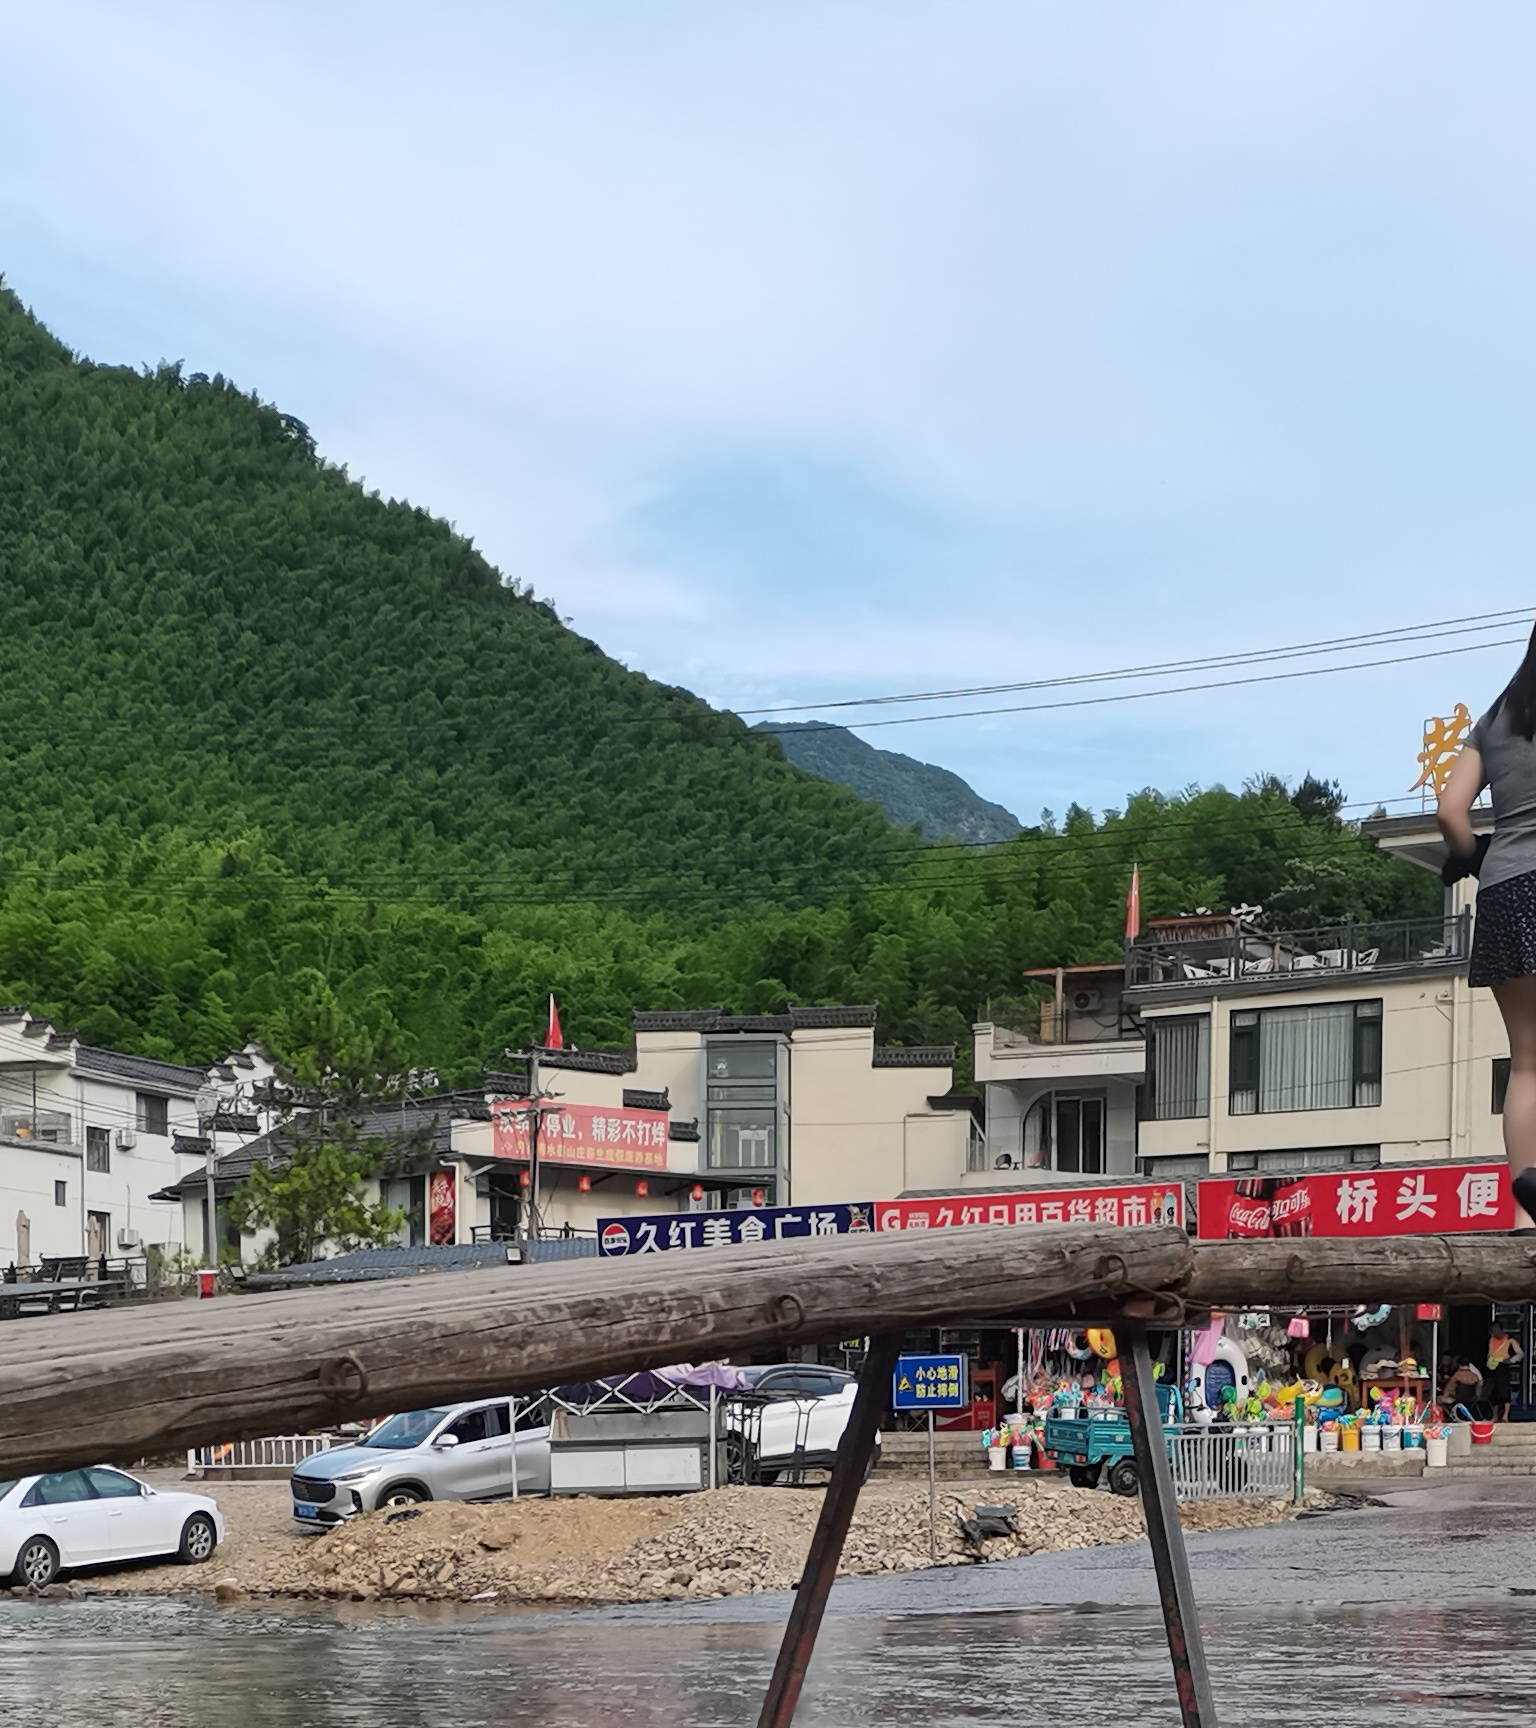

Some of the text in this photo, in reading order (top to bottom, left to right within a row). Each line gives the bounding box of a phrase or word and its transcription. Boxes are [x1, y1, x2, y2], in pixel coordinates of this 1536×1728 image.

[936, 1195, 1147, 1228] 久红日用百货超市
[635, 1211, 839, 1254] 久红美食广场
[915, 1365, 959, 1381] 小心地滑
